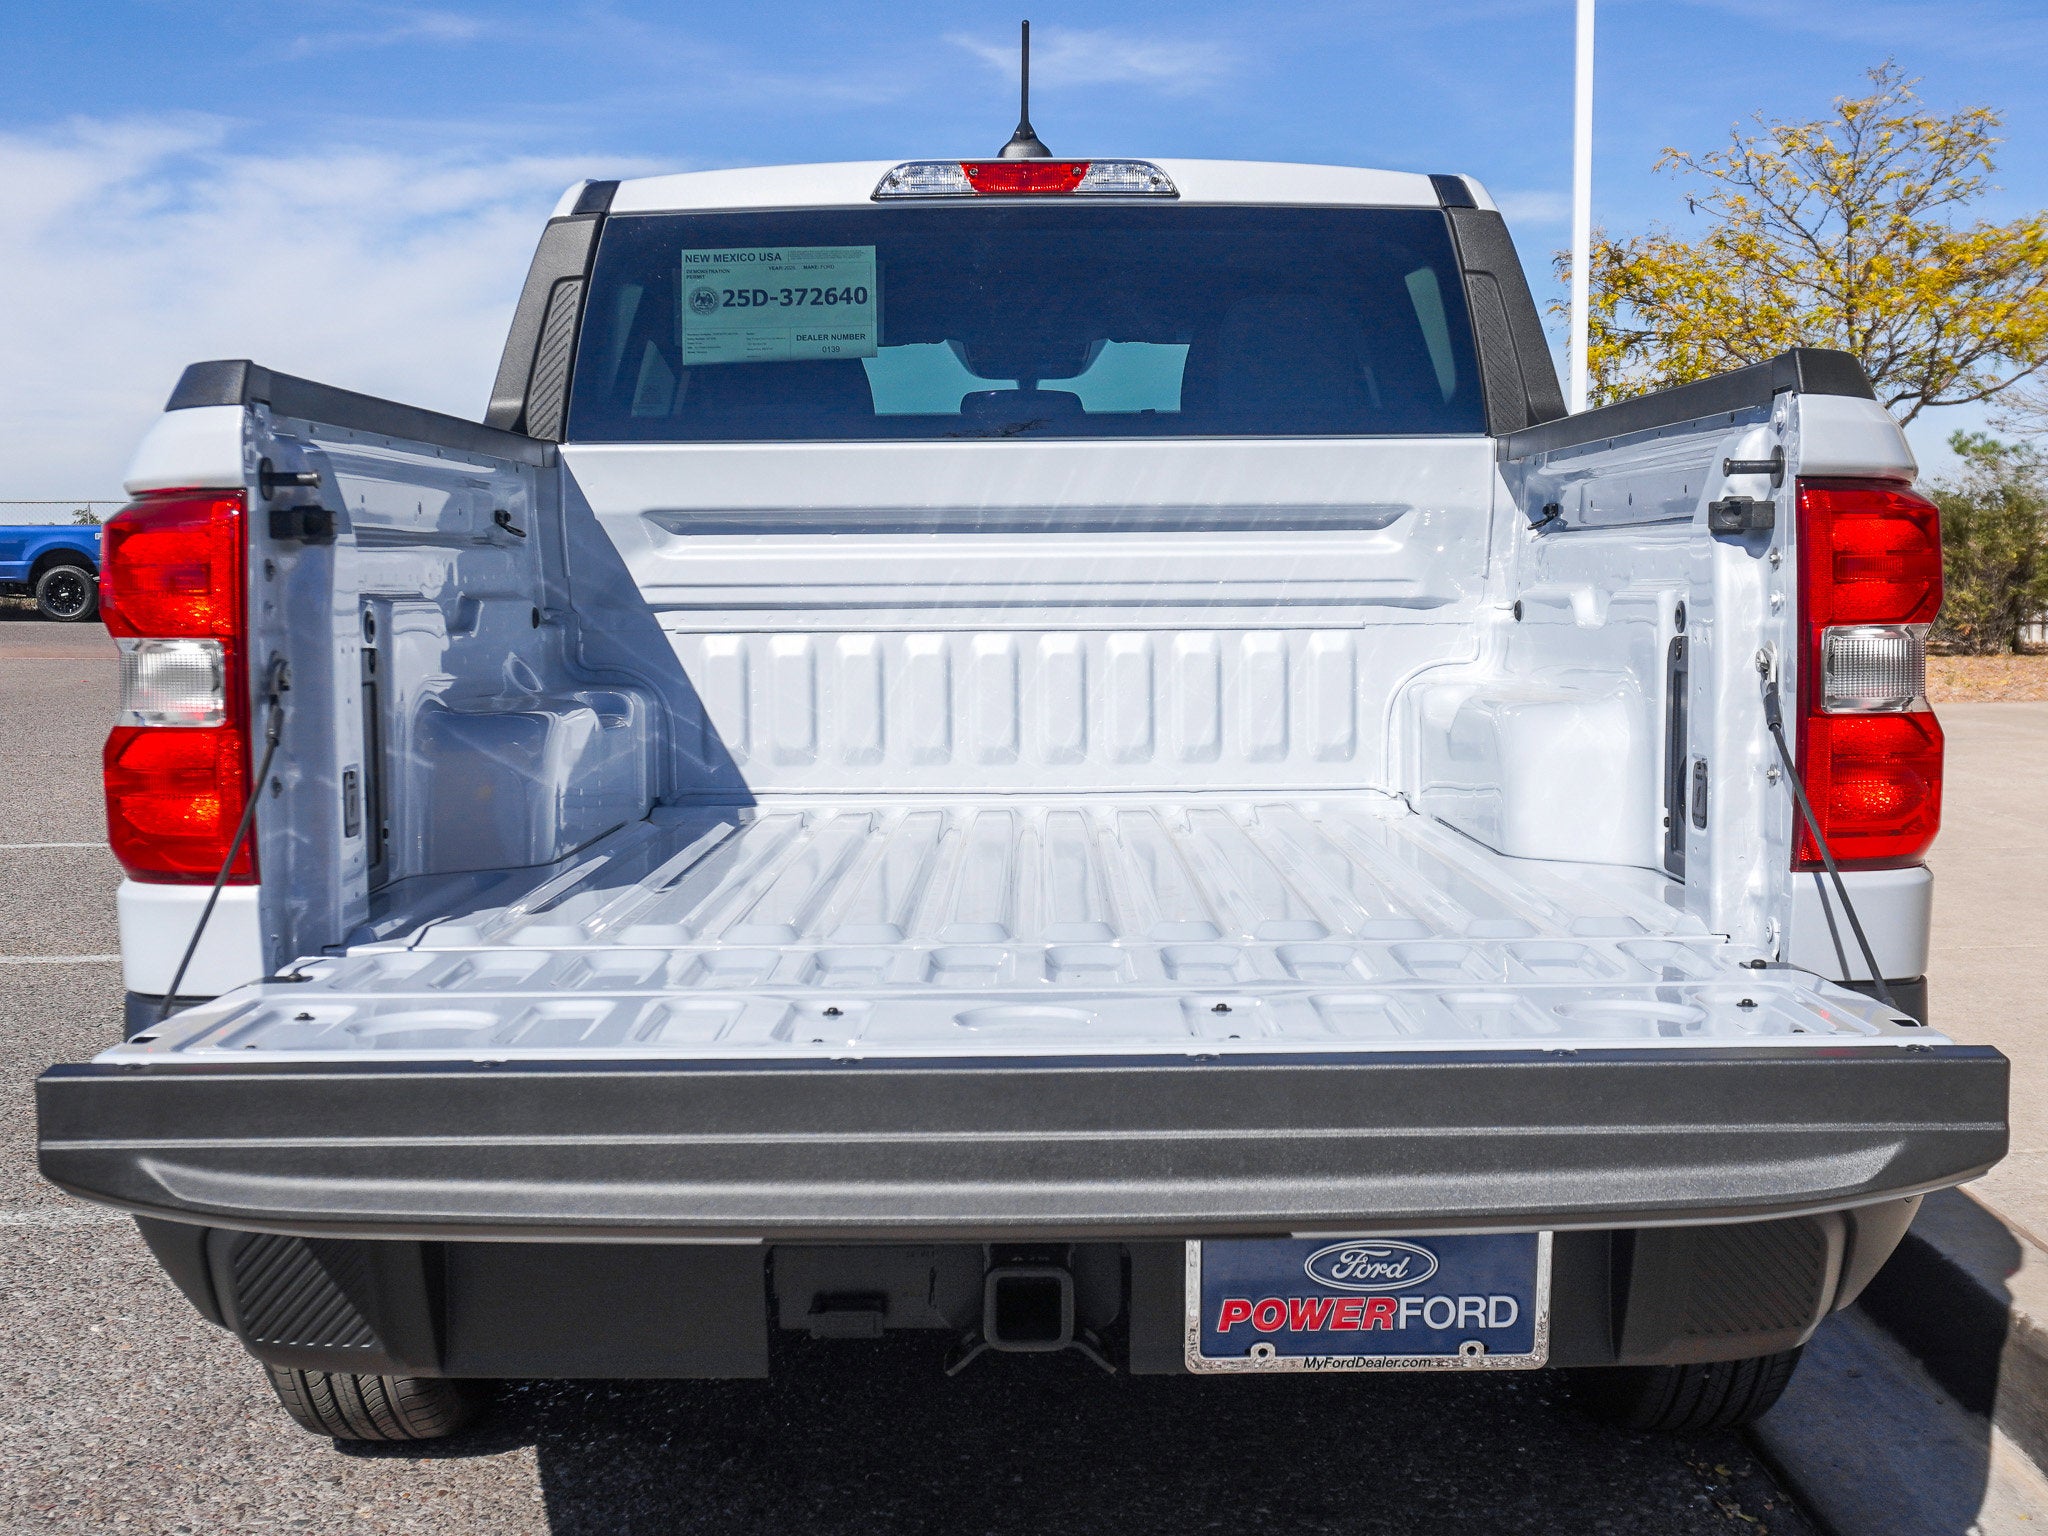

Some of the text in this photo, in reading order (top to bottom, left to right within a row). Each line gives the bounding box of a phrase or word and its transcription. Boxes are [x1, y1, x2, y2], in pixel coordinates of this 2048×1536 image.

[685, 254, 711, 263] NEW
[713, 252, 756, 263] MEXICO
[759, 252, 782, 262] USA
[722, 286, 868, 307] 25D-372640
[796, 333, 866, 342] DEALER NUMBER
[821, 345, 841, 354] 0139
[1331, 1249, 1411, 1280] Ford
[1303, 1356, 1432, 1370] MyFordDealer.com
